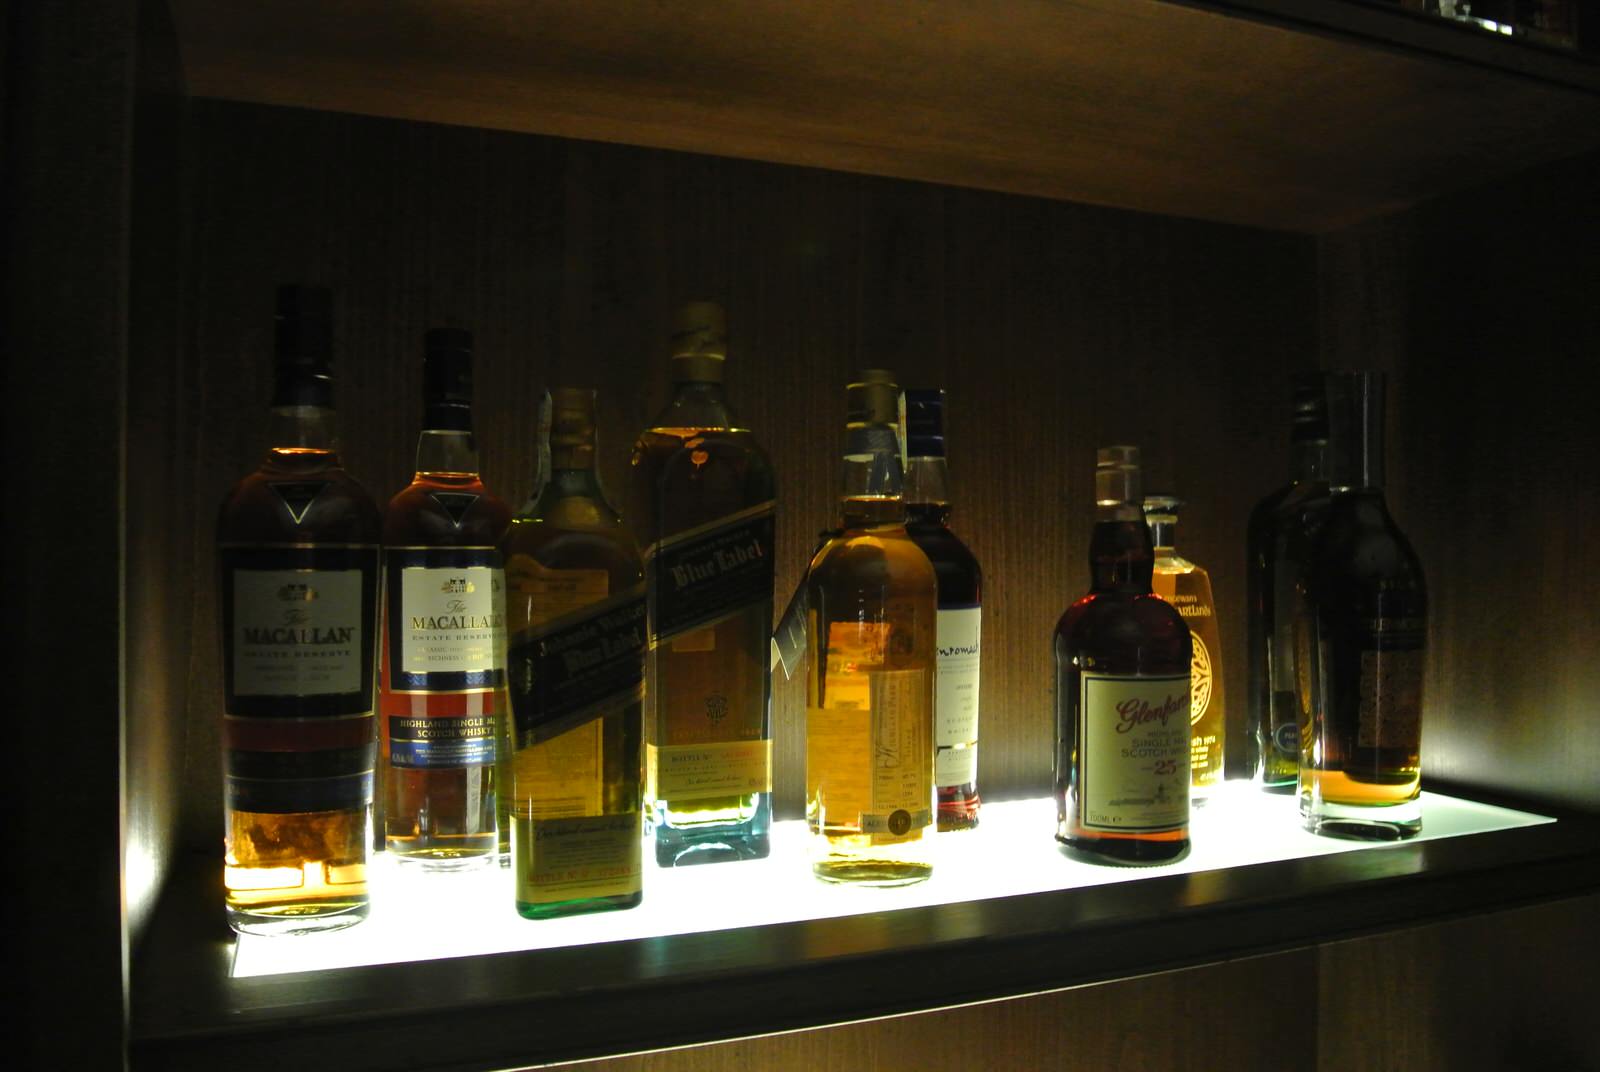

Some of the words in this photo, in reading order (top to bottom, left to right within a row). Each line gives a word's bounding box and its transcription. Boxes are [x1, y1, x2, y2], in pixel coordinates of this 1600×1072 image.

[242, 626, 356, 645] MACALLAN
[457, 727, 491, 738] WHISKY
[1154, 759, 1177, 776] 25
